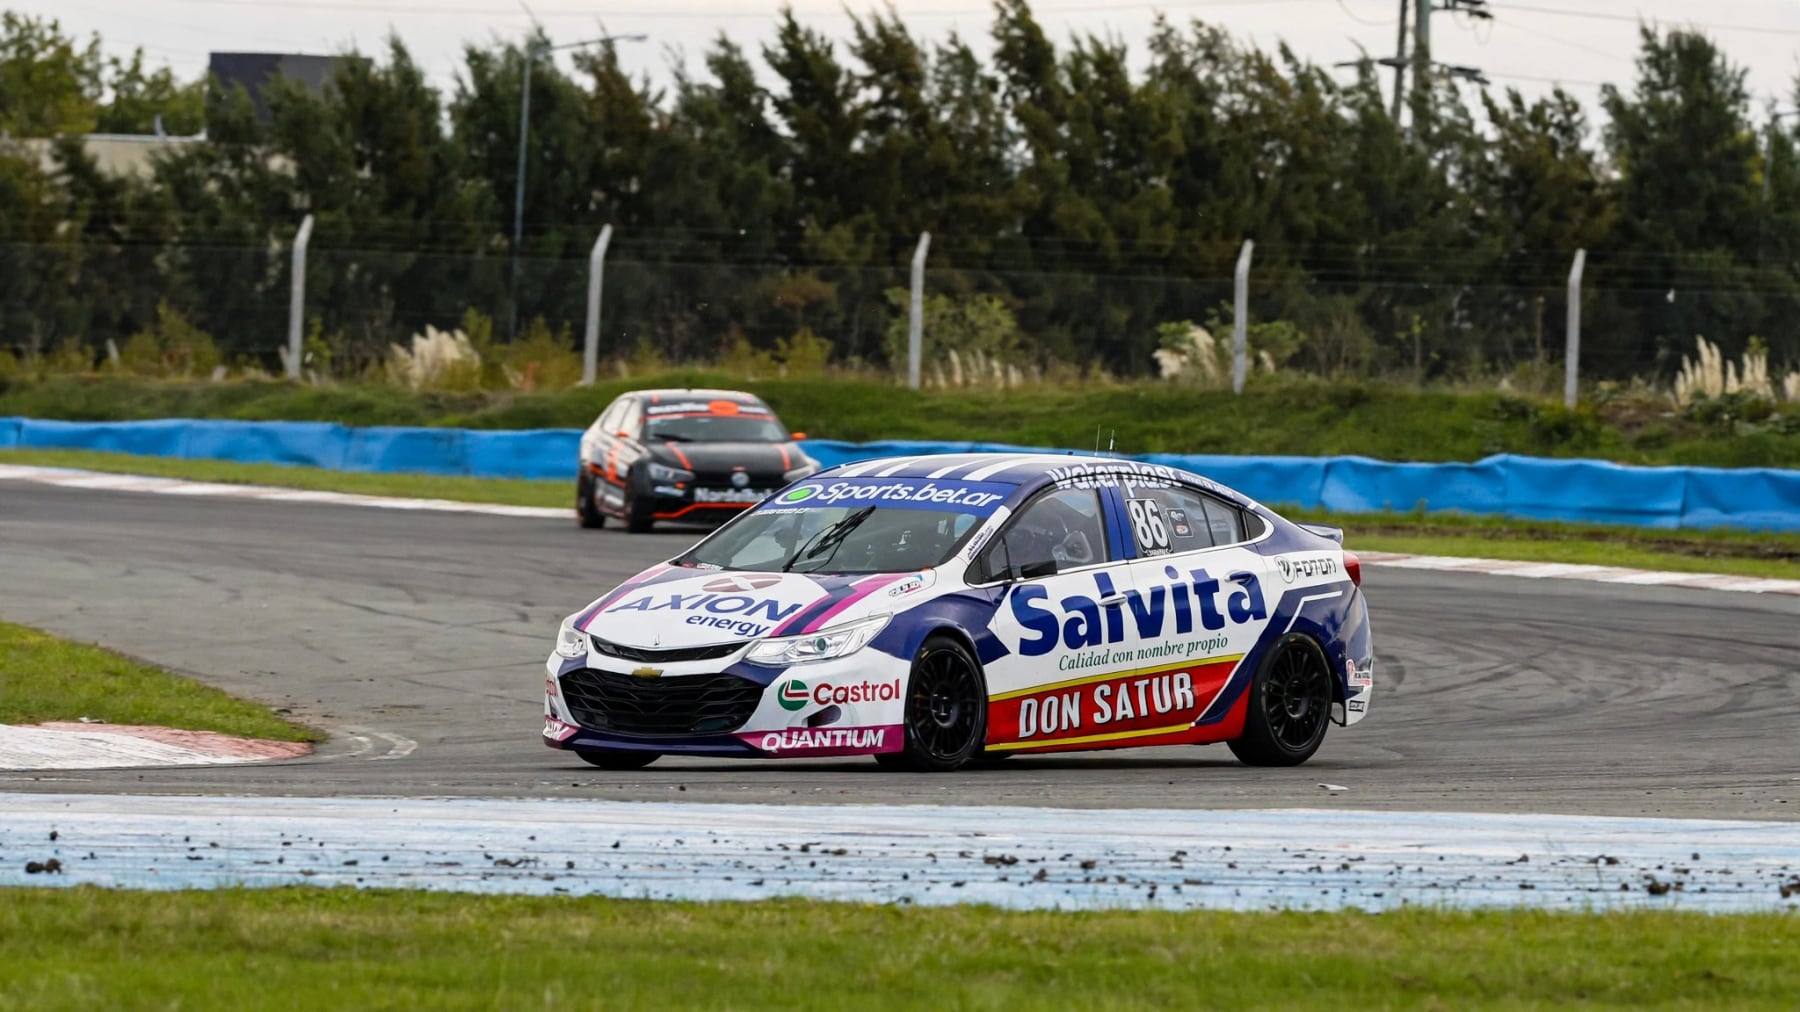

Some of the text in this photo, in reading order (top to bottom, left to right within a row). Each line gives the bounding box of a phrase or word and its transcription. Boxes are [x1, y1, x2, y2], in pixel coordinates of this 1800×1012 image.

[817, 481, 1003, 507] Sports.bet.ar
[1129, 500, 1168, 549] 86
[605, 594, 803, 621] AXION
[1010, 564, 1267, 656] Salvita
[685, 613, 772, 637] energy
[1059, 633, 1228, 671] Calidad con nombre propio
[813, 678, 900, 705] Castrol
[1018, 672, 1195, 738] DON SATUR
[761, 729, 884, 753] QUANTIUM
